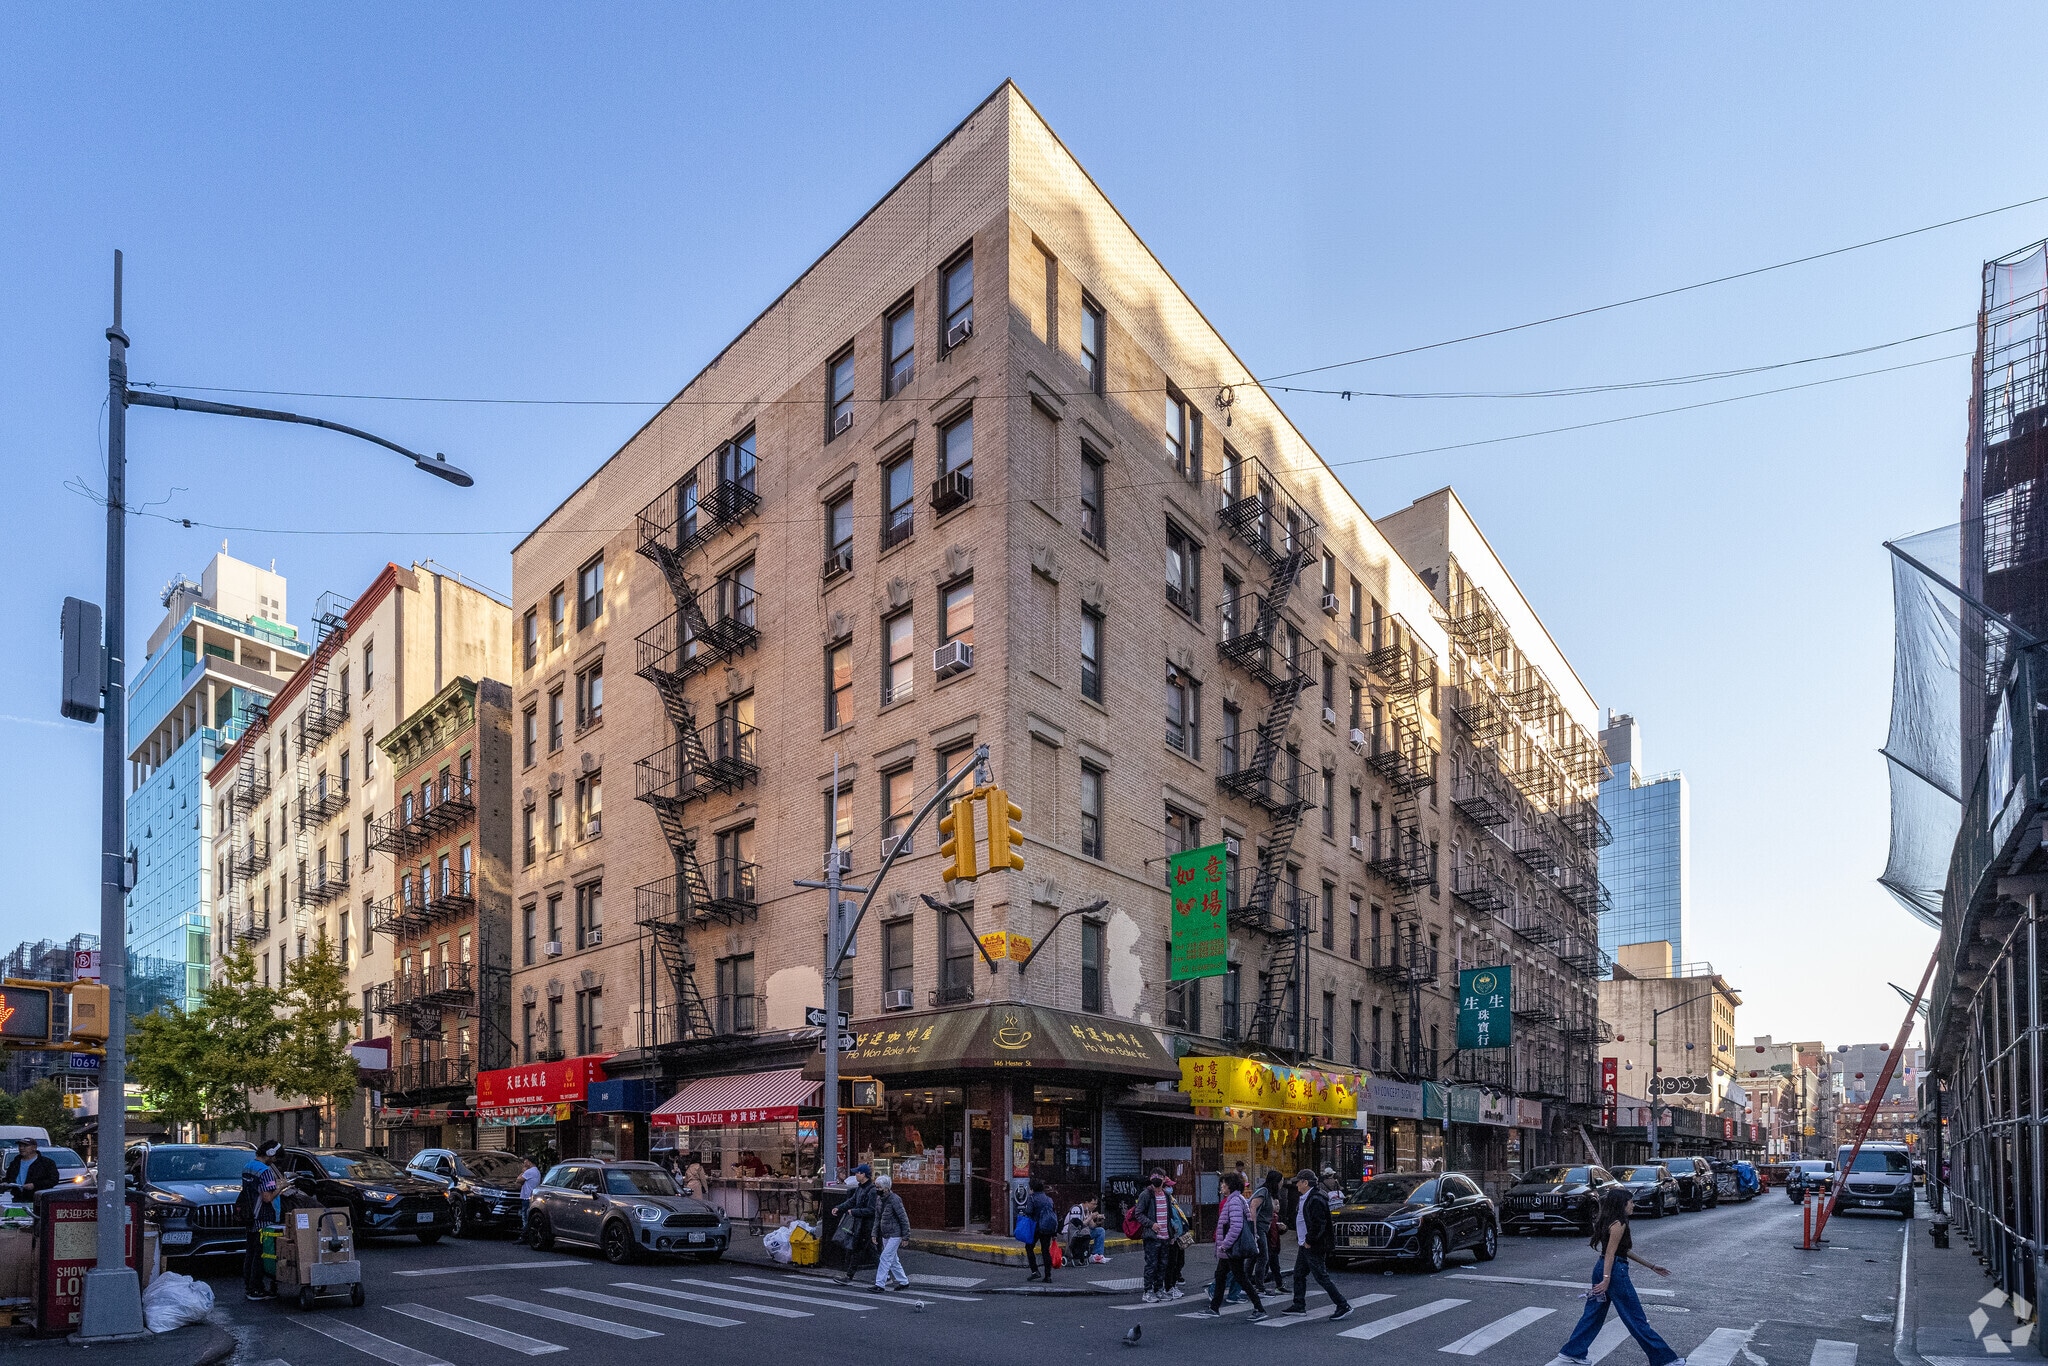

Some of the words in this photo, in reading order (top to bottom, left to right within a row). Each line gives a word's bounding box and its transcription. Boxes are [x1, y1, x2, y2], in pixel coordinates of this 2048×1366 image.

[812, 1014, 825, 1023] ONE
[1477, 1009, 1490, 1046] 珠寶行
[846, 1051, 860, 1060] Ho
[862, 1048, 881, 1058] Won
[882, 1045, 905, 1056] Bake
[1083, 1042, 1098, 1052] Ho
[1100, 1045, 1118, 1056] Won
[1117, 1047, 1138, 1058] Bake
[56, 1208, 98, 1219] 歡迎來
